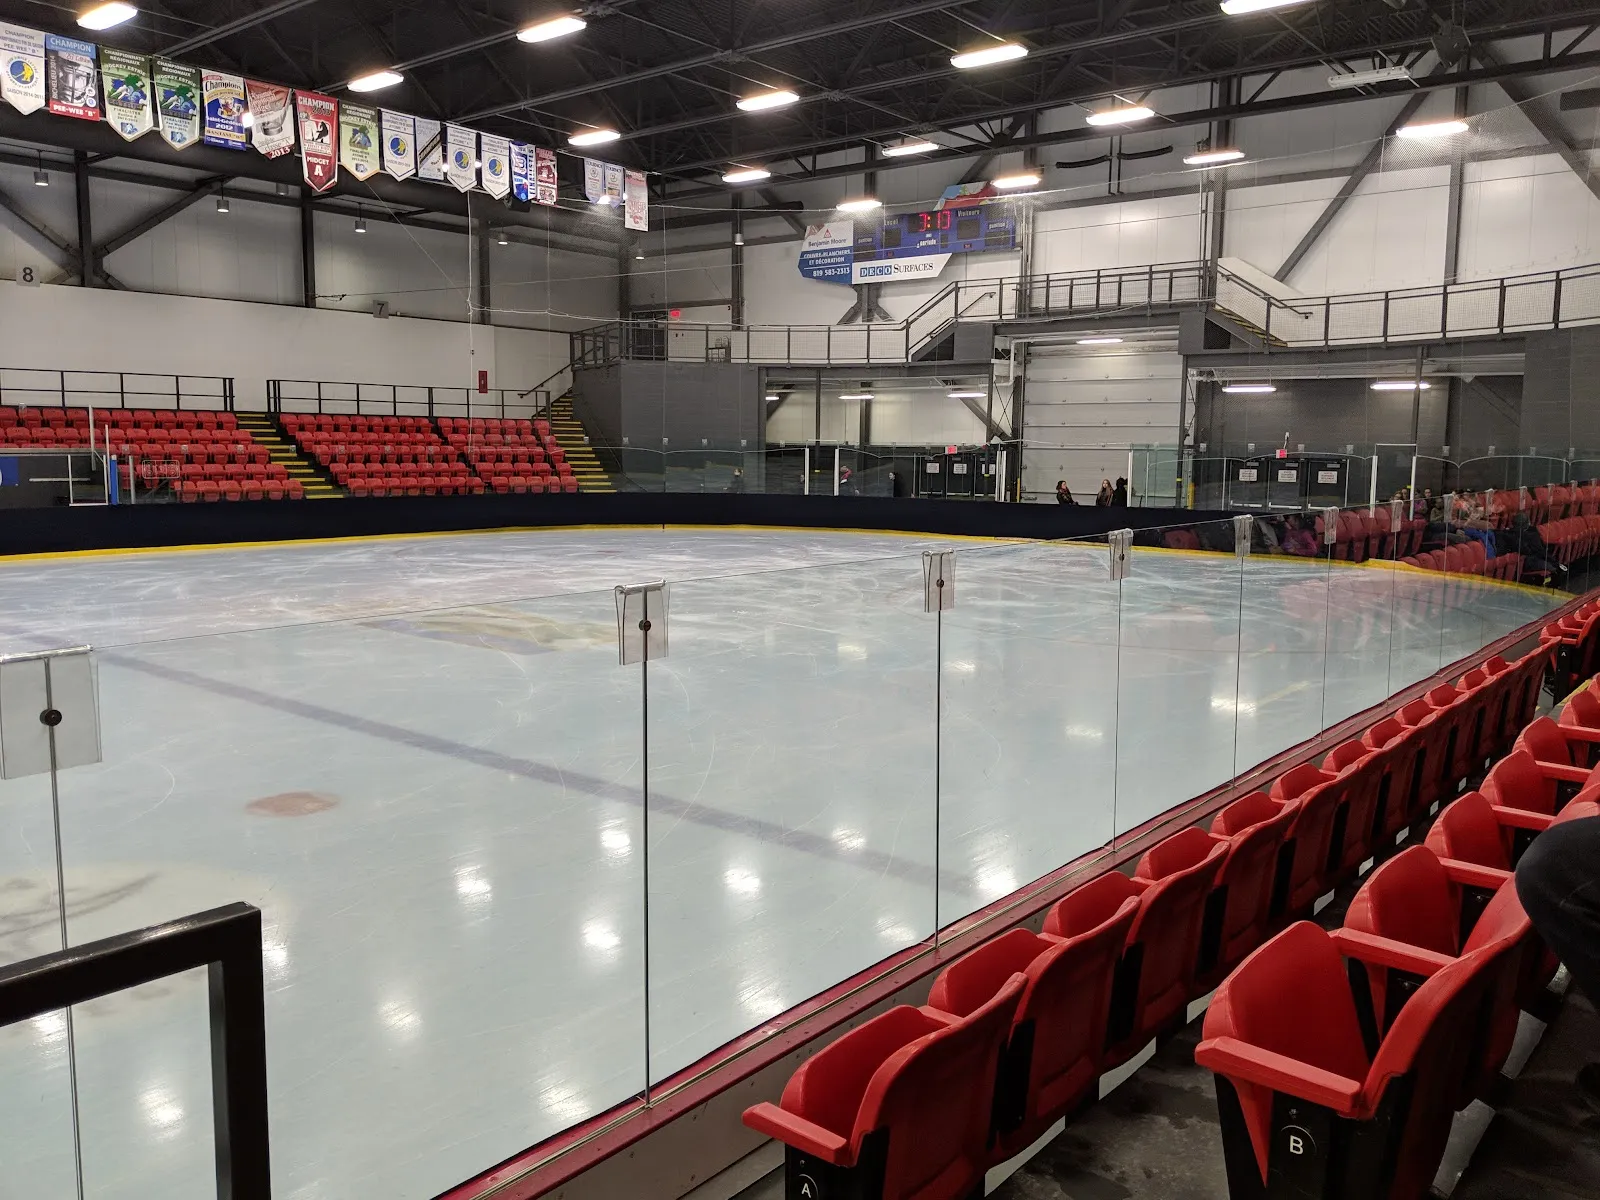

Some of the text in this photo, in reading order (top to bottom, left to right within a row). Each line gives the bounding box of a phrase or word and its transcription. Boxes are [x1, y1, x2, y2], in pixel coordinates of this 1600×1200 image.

[5, 29, 35, 40] CHAMPION
[50, 37, 92, 52] CHAMPION
[205, 80, 242, 92] Champions
[298, 96, 335, 111] CHAMPION
[53, 104, 84, 116] PEE-WEE
[270, 147, 290, 158] 2013
[306, 156, 330, 166] MIDGET
[314, 164, 324, 176] A
[808, 240, 830, 248] Benjamin
[22, 266, 34, 282] 8
[377, 302, 384, 316] 7
[1290, 1134, 1304, 1154] B
[802, 1182, 812, 1198] A
